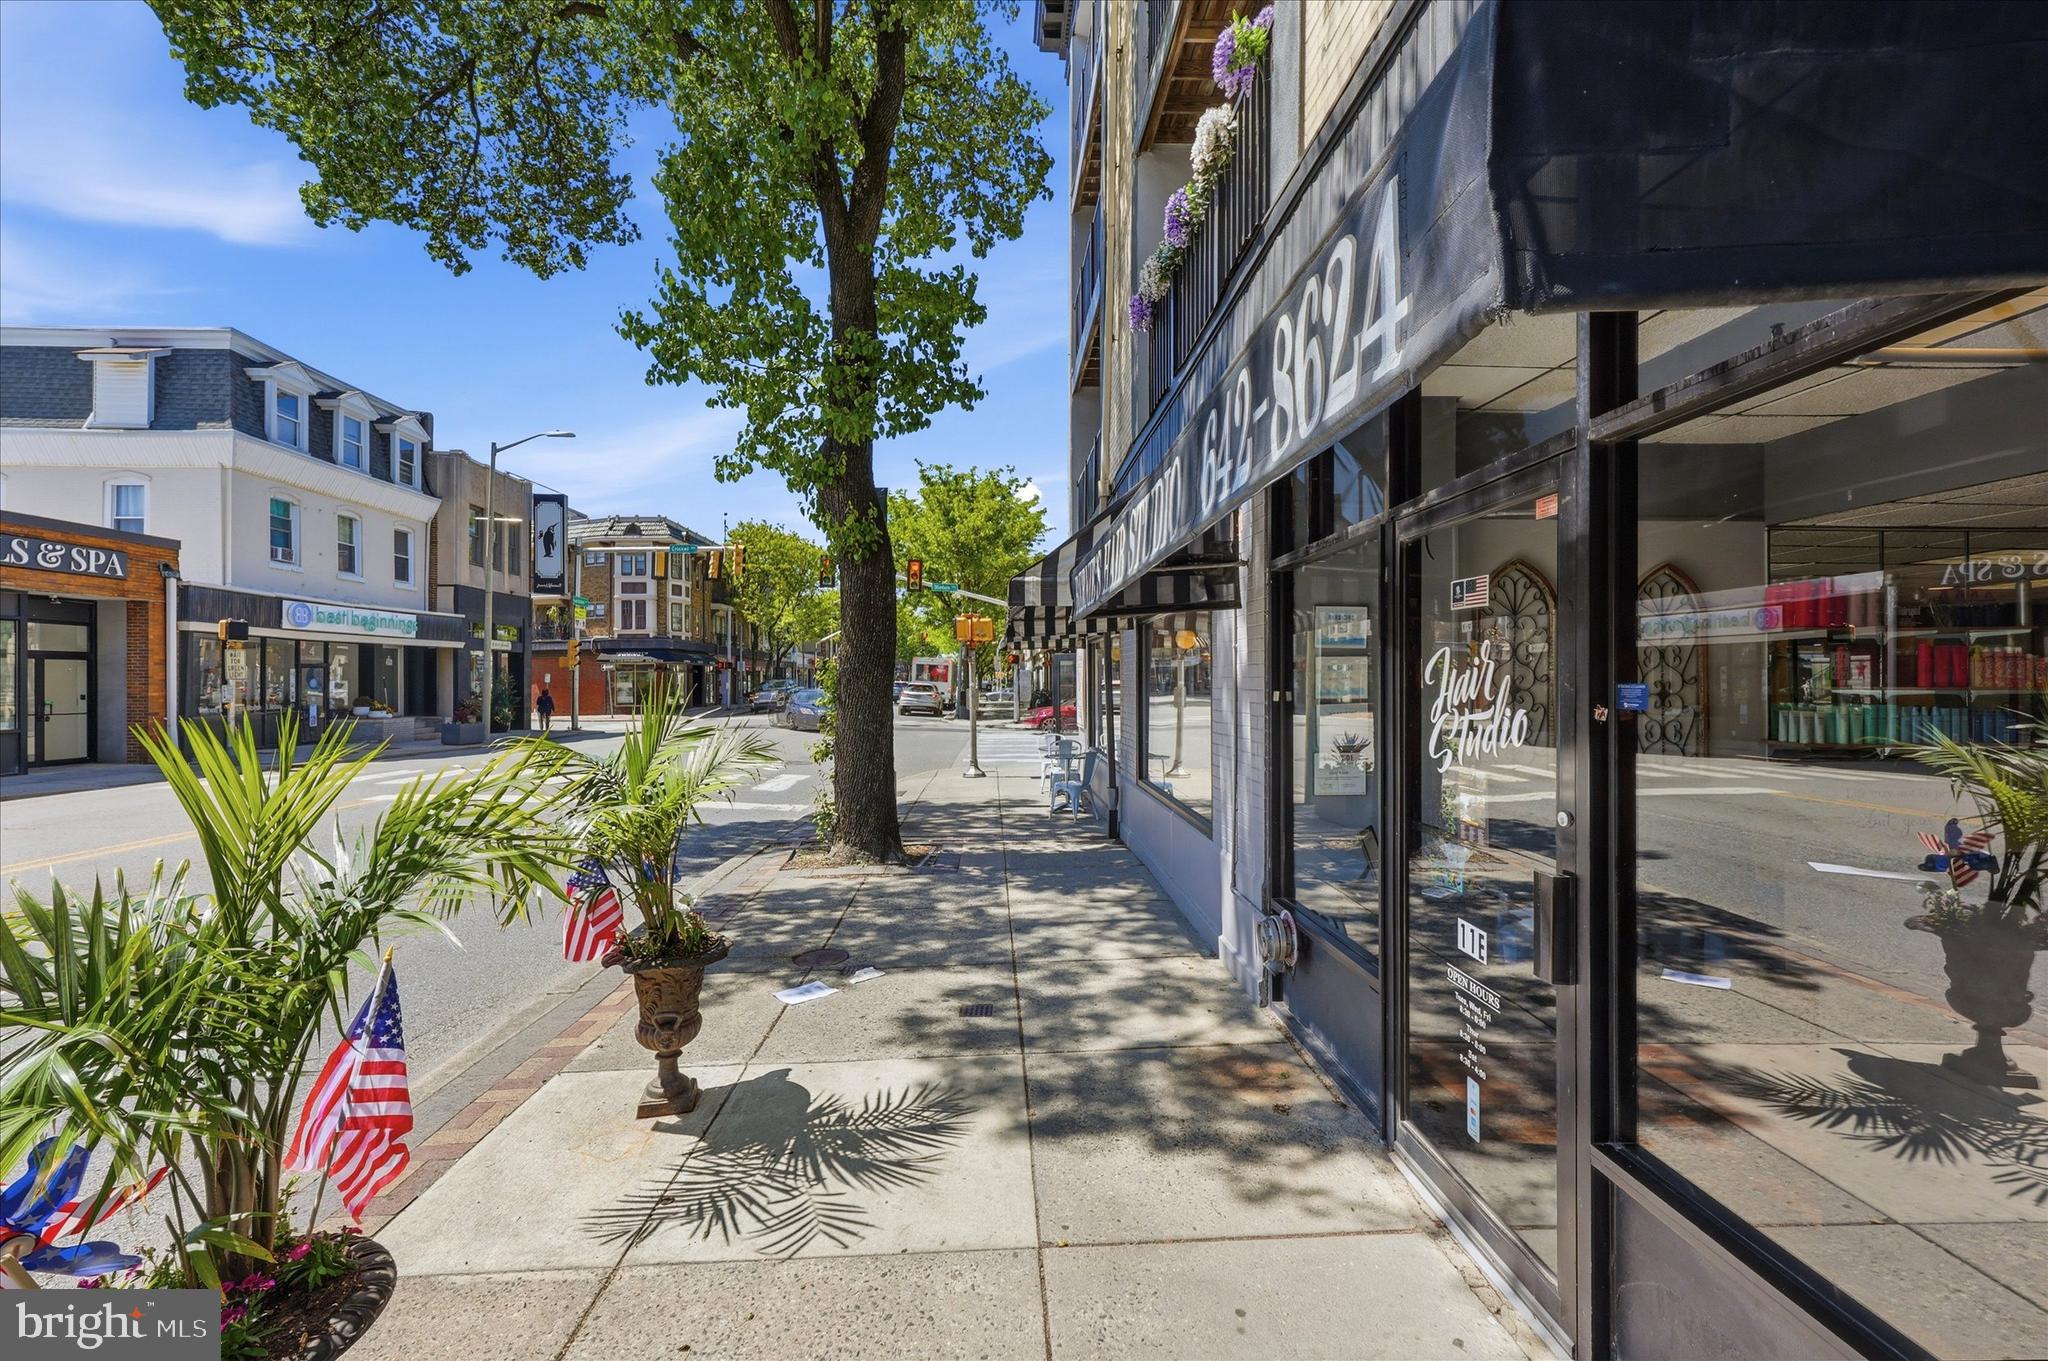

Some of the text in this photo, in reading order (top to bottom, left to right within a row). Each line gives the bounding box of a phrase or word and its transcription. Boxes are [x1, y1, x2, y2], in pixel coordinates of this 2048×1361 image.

[1128, 456, 1182, 577] STUDIO
[1201, 175, 1413, 517] 642-8624
[37, 543, 66, 568] &
[70, 547, 124, 576] SPA
[316, 606, 346, 625] best
[352, 609, 418, 635] beginnings
[1425, 639, 1495, 723] Hair
[1428, 674, 1528, 773] Studio
[1460, 922, 1485, 962] 11E
[1447, 967, 1500, 1009] OPEN HOURS
